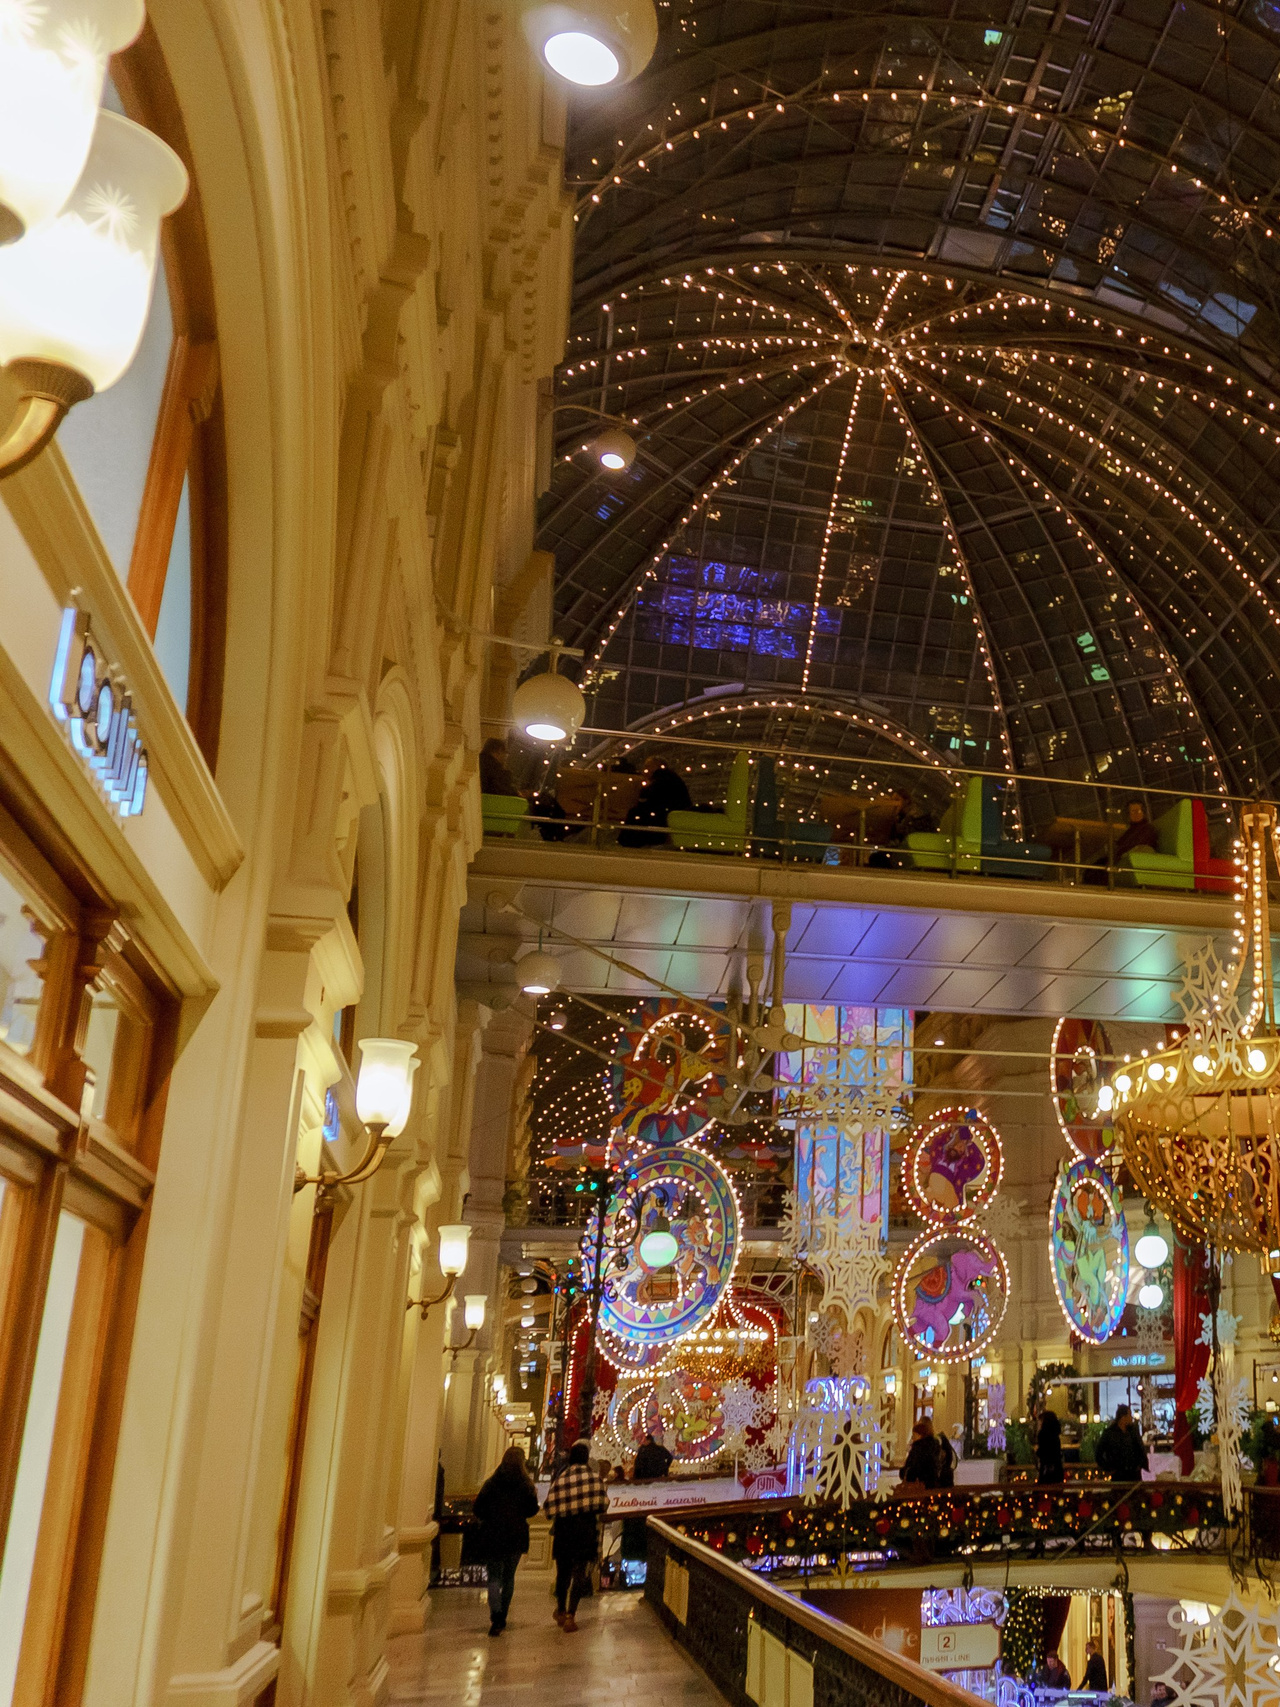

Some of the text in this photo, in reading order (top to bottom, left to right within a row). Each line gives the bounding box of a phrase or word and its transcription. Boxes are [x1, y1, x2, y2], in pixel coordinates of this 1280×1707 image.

[612, 1496, 707, 1509] Главный магазин
[943, 1636, 951, 1649] 2
